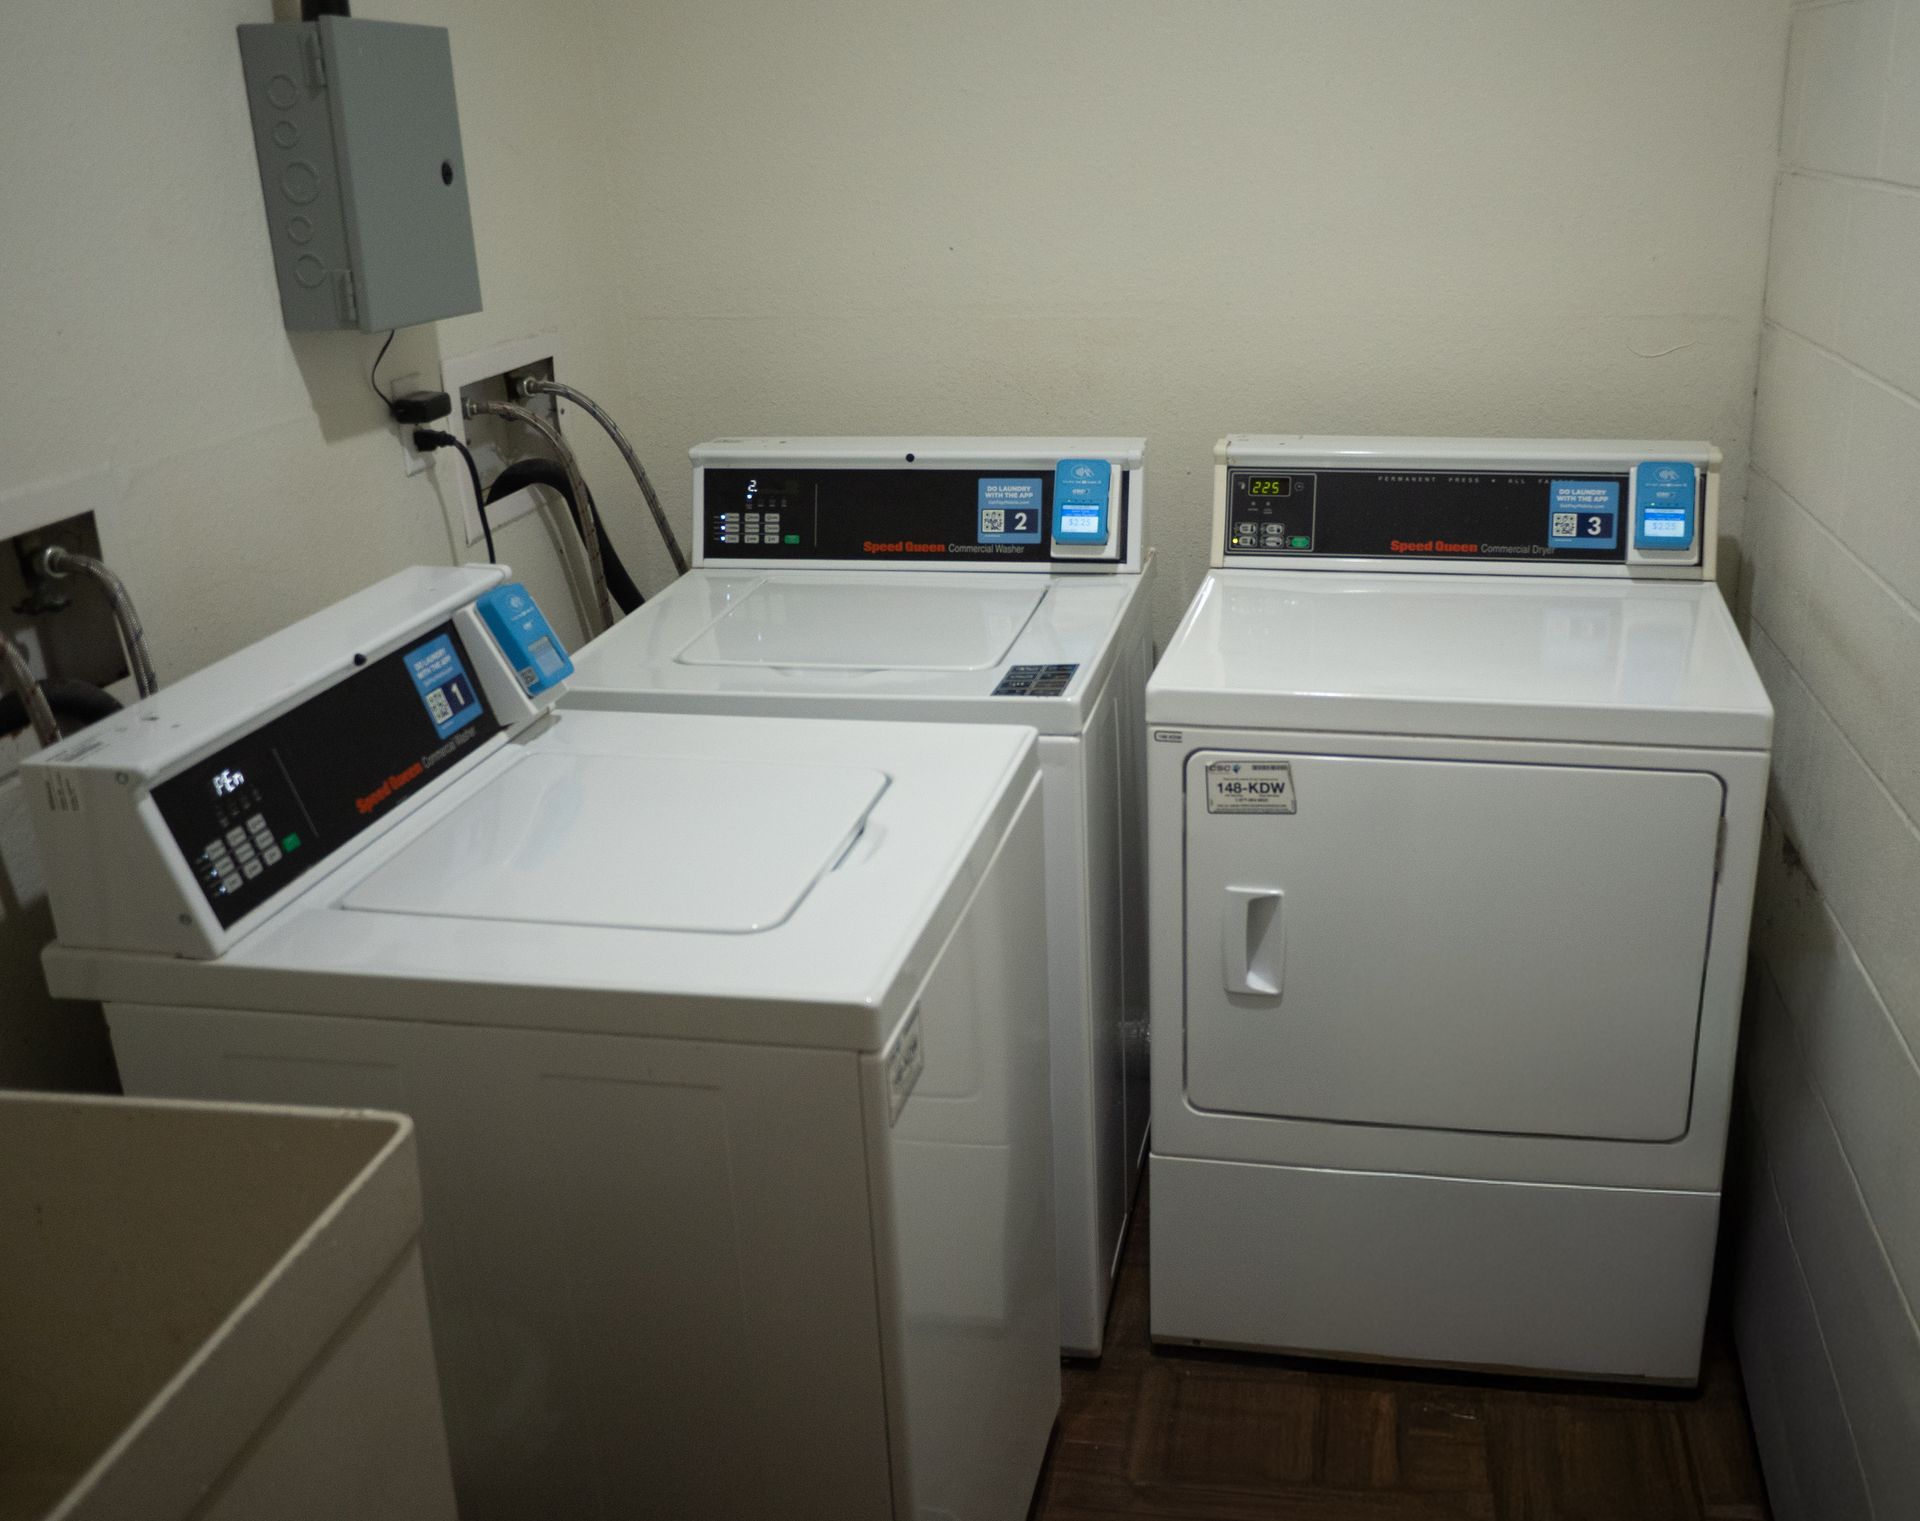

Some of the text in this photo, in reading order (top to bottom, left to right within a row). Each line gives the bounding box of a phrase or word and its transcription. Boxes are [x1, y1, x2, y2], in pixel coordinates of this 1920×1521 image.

[1014, 511, 1028, 530] 2
[1587, 516, 1602, 535] 3
[863, 540, 1025, 554] Speed Queen Commercial Washer
[1391, 540, 1433, 553] Speed
[1435, 541, 1478, 553] Queen
[1480, 543, 1530, 553] Commercial
[451, 683, 465, 706] 1
[1216, 782, 1286, 794] 148-KDW
